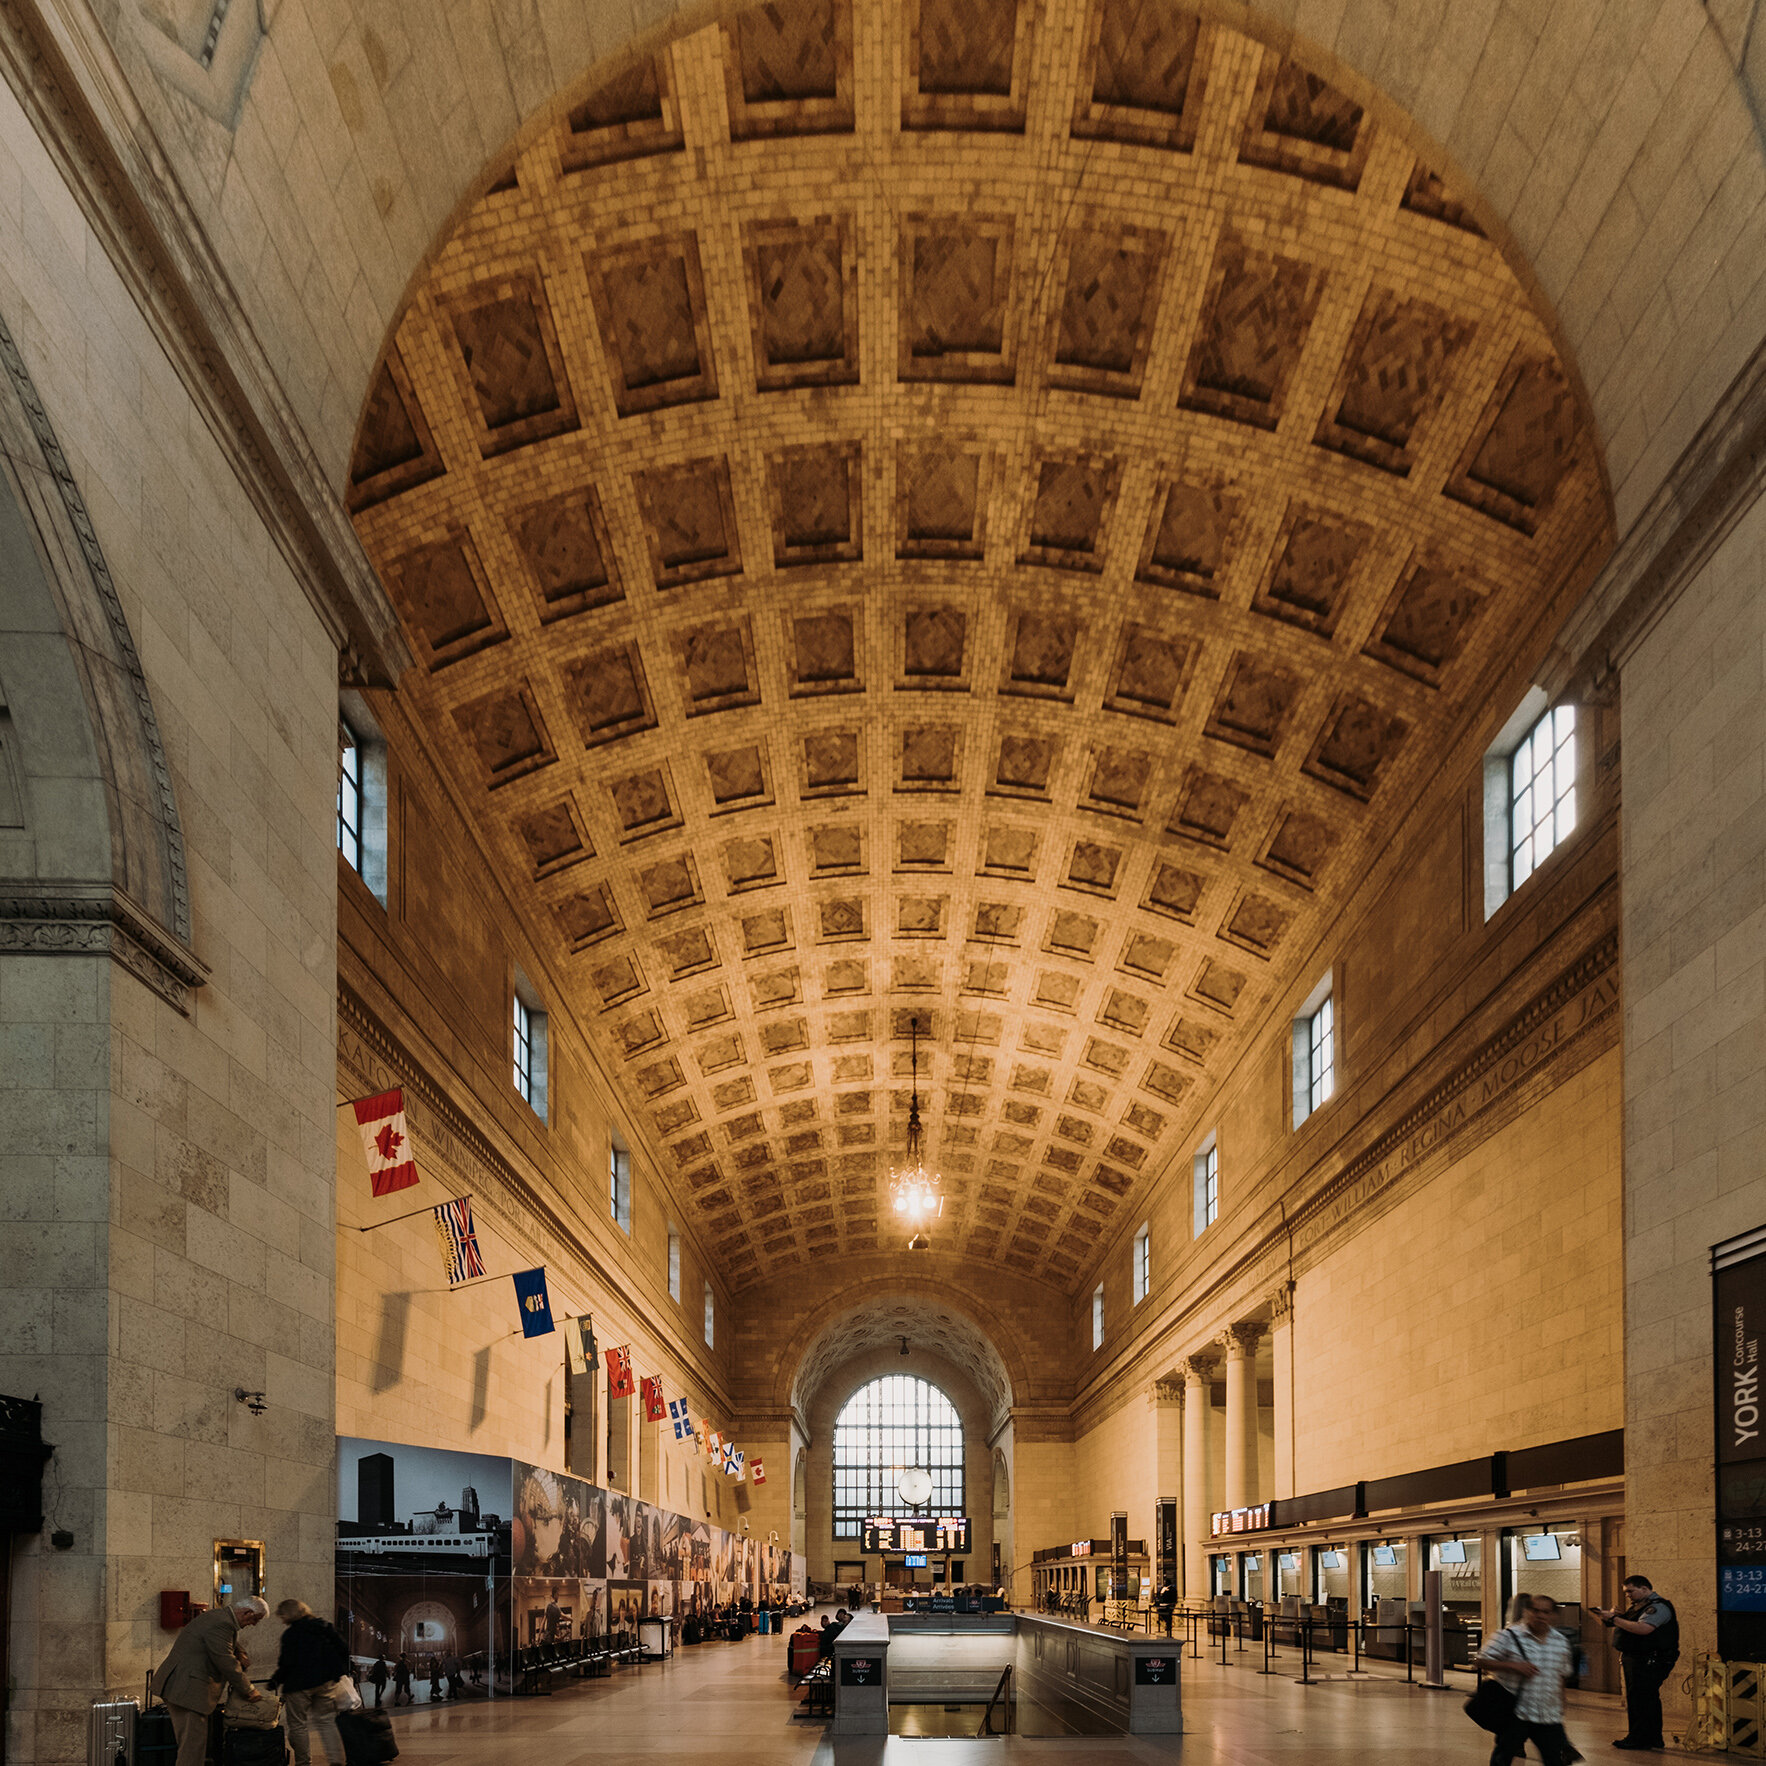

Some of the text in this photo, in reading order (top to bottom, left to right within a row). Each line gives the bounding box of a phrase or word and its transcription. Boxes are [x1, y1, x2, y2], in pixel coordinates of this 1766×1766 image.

[1401, 1102, 1466, 1167] REGINA
[1482, 1016, 1567, 1102] MOOSE
[431, 1119, 494, 1197] WINNIPEG
[1733, 1306, 1759, 1447] YORK Concourse
[1746, 1339, 1758, 1364] Hall
[1735, 1528, 1762, 1539] 3-13
[1736, 1570, 1763, 1581] 3-13
